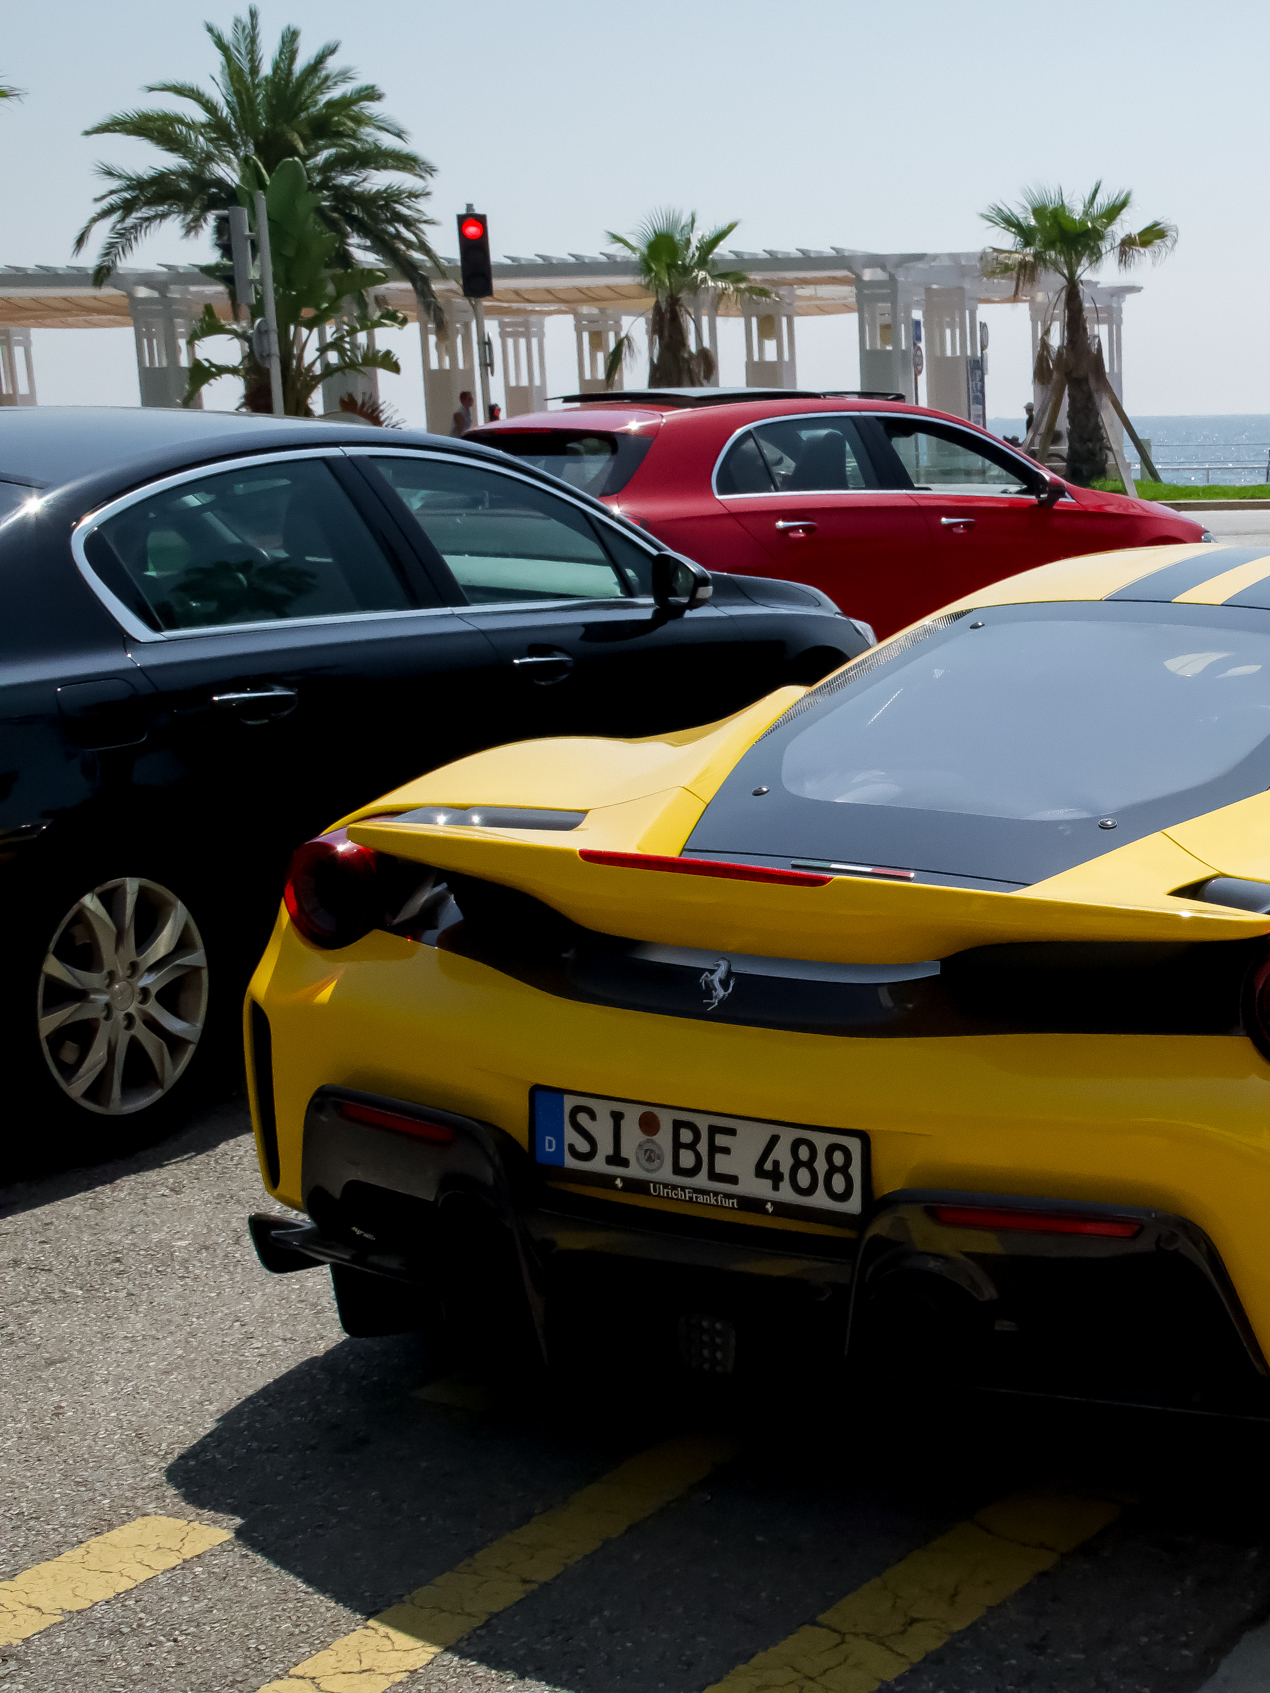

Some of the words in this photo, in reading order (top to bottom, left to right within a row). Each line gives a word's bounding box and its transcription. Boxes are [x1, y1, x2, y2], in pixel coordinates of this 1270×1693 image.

[545, 1136, 556, 1152] D
[568, 1104, 630, 1169] SI
[671, 1118, 740, 1186] BE
[754, 1133, 855, 1203] 488
[650, 1182, 739, 1209] UlrichFrankfurt
